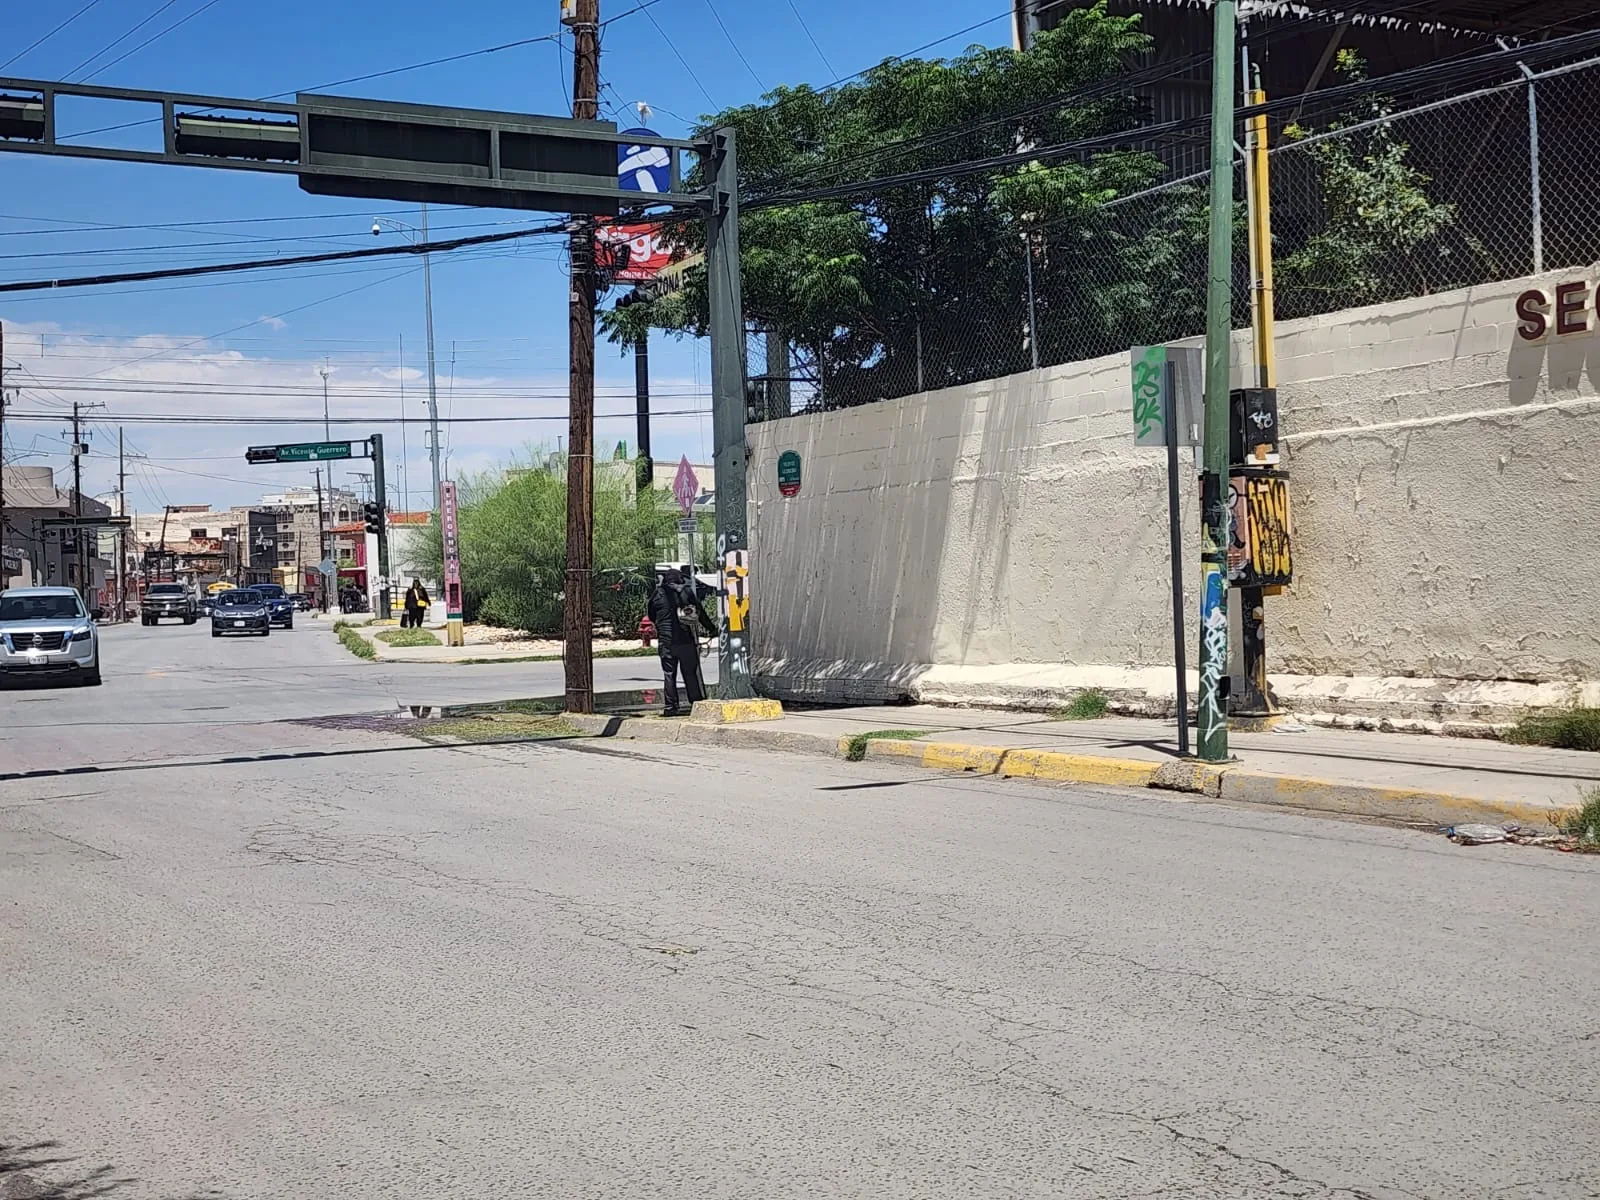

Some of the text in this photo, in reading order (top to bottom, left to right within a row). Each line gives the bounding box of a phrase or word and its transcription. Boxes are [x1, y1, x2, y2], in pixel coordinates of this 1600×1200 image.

[1515, 281, 1600, 341] SE
[290, 447, 315, 456] Vicente
[316, 446, 347, 455] Guerrero
[445, 493, 456, 569] EMERGENCIA
